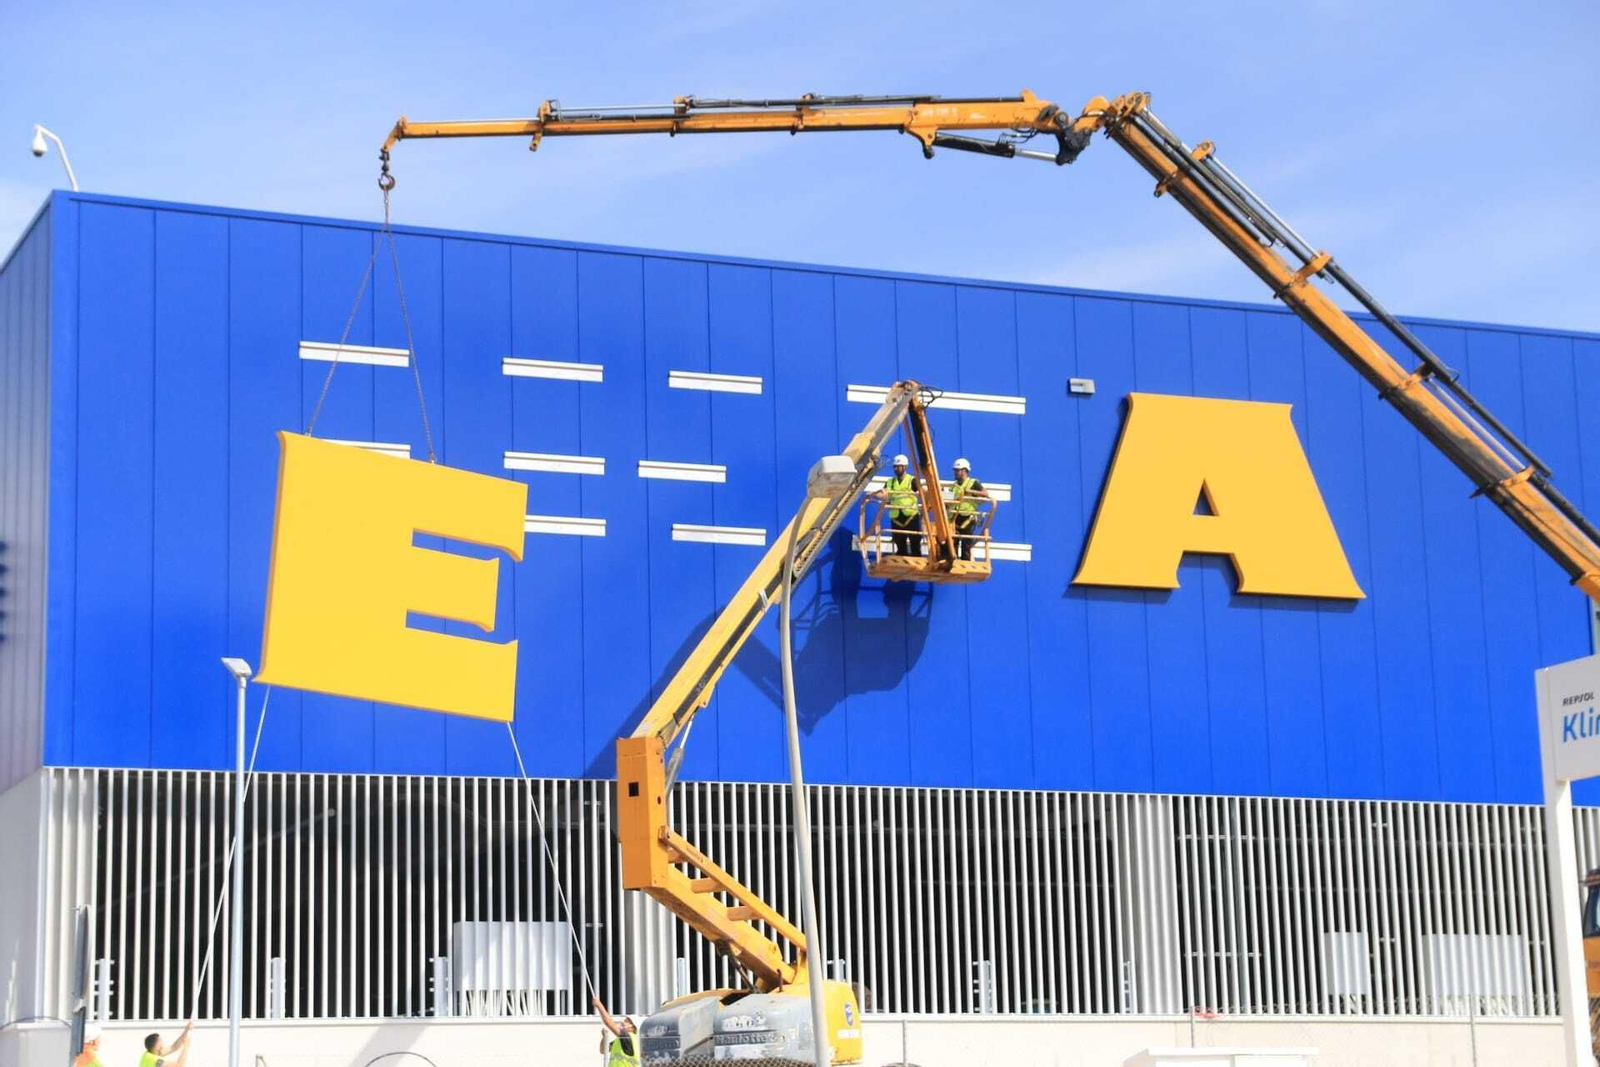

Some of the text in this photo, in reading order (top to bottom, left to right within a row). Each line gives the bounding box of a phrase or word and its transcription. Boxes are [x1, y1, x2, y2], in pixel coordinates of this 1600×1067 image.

[252, 430, 528, 722] E
[1070, 392, 1367, 599] A
[1563, 691, 1594, 706] REPSOL
